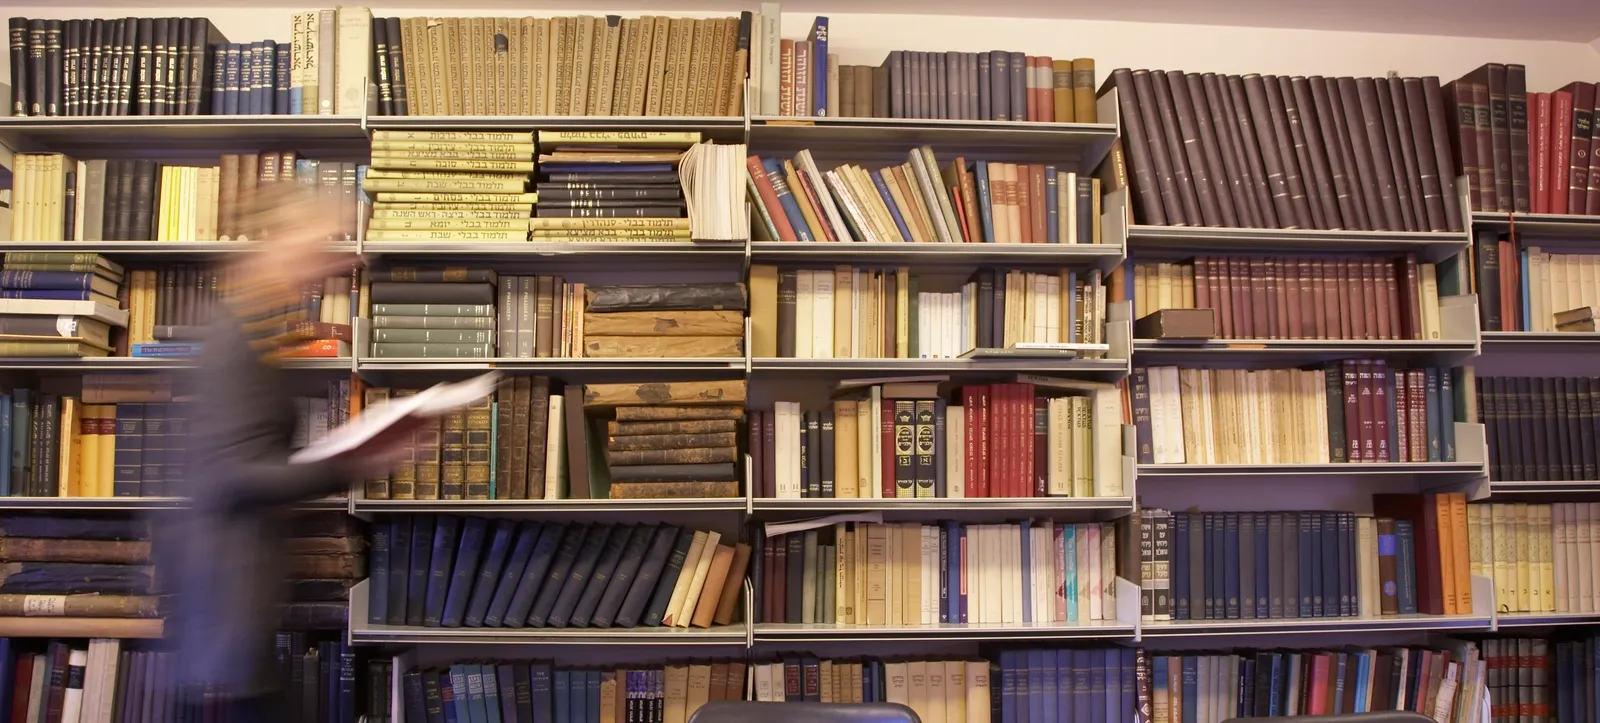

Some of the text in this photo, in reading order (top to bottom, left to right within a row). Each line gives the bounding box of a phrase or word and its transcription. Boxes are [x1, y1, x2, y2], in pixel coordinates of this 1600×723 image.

[442, 210, 464, 218] ביצה
[461, 220, 481, 228] בבלי
[583, 219, 616, 228] סנהדרין
